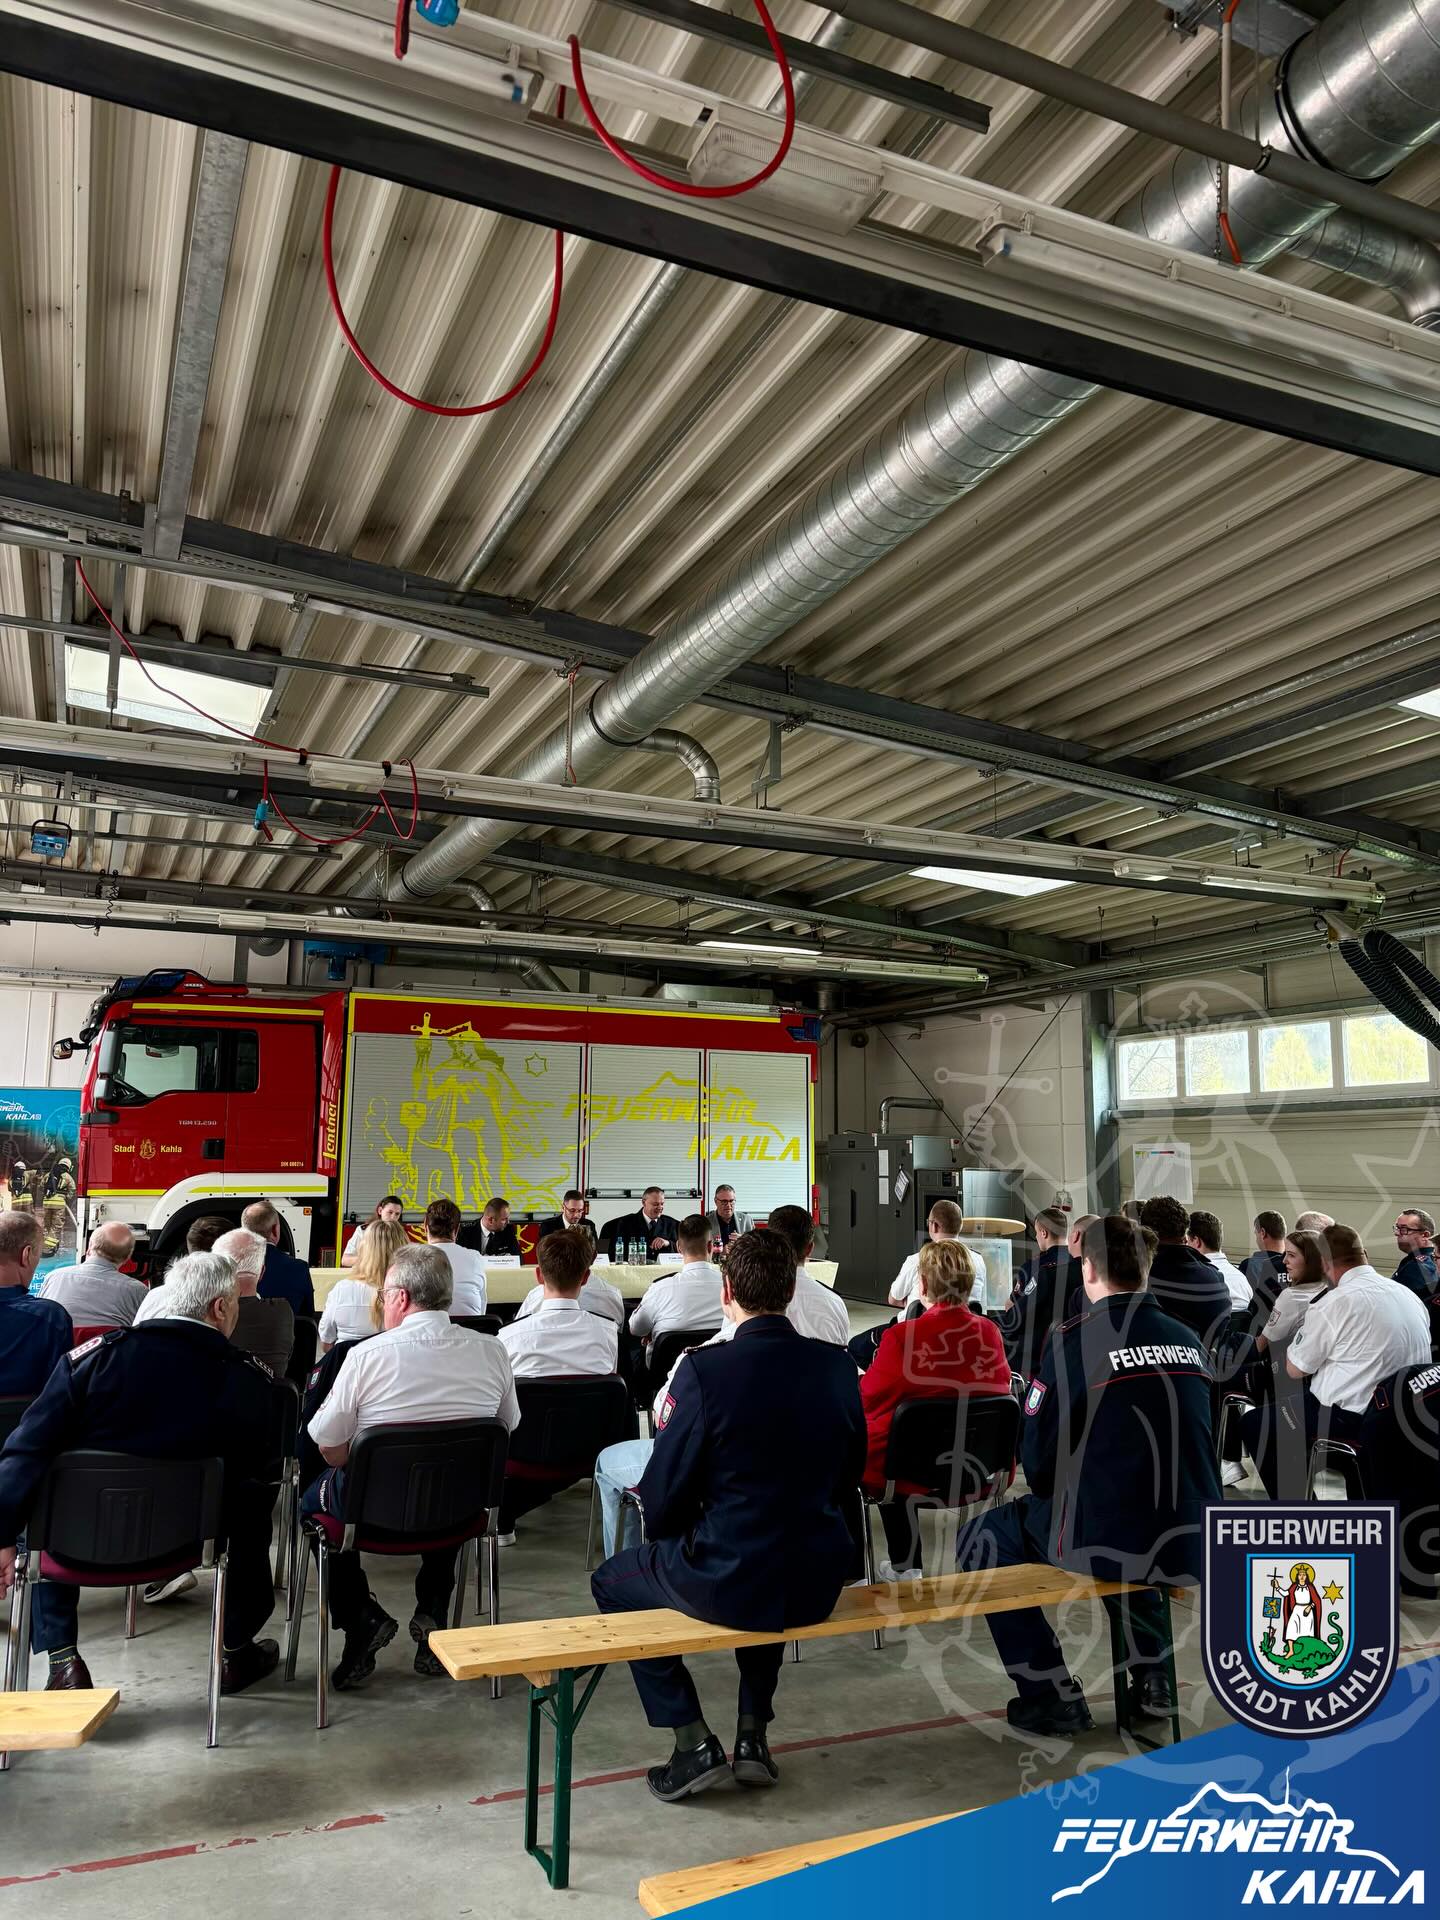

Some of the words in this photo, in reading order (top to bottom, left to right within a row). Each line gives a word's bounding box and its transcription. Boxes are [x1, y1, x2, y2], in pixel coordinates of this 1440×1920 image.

[561, 1094, 757, 1123] FEUERWEHR
[114, 1144, 135, 1153] Stadt
[160, 1144, 183, 1153] Kahla
[1108, 1345, 1204, 1371] FEUERWEHR
